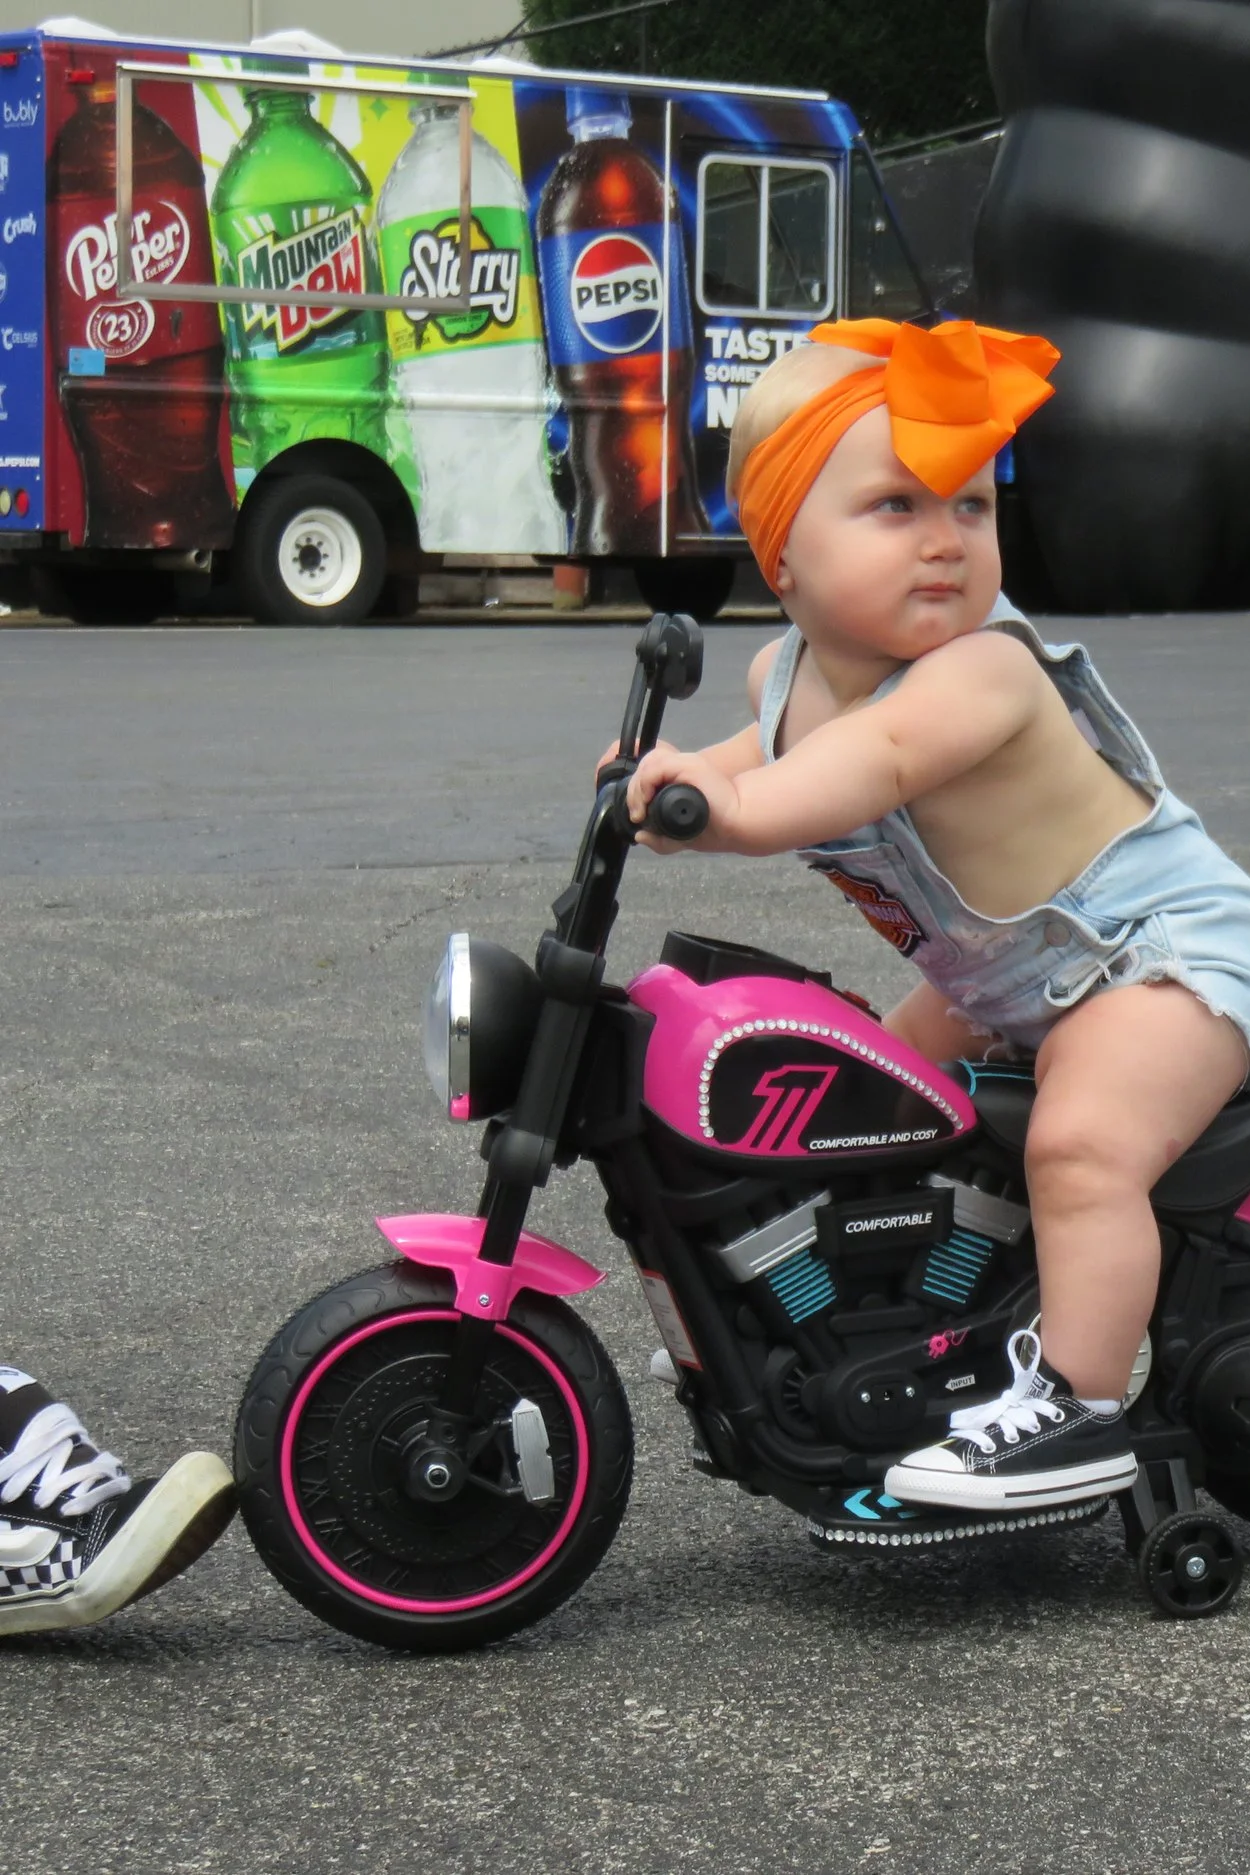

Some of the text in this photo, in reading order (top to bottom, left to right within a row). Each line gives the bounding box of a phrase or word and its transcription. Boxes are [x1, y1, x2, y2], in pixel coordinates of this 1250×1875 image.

[66, 222, 181, 301] Peper
[576, 278, 659, 310] PEPSI
[104, 313, 132, 343] 23
[704, 327, 809, 361] TAST
[704, 363, 768, 384] SOME
[809, 1129, 938, 1150] COMFORTABLE AND COSY
[845, 1212, 933, 1234] COMFORTABLE
[949, 1377, 973, 1389] INPUT
